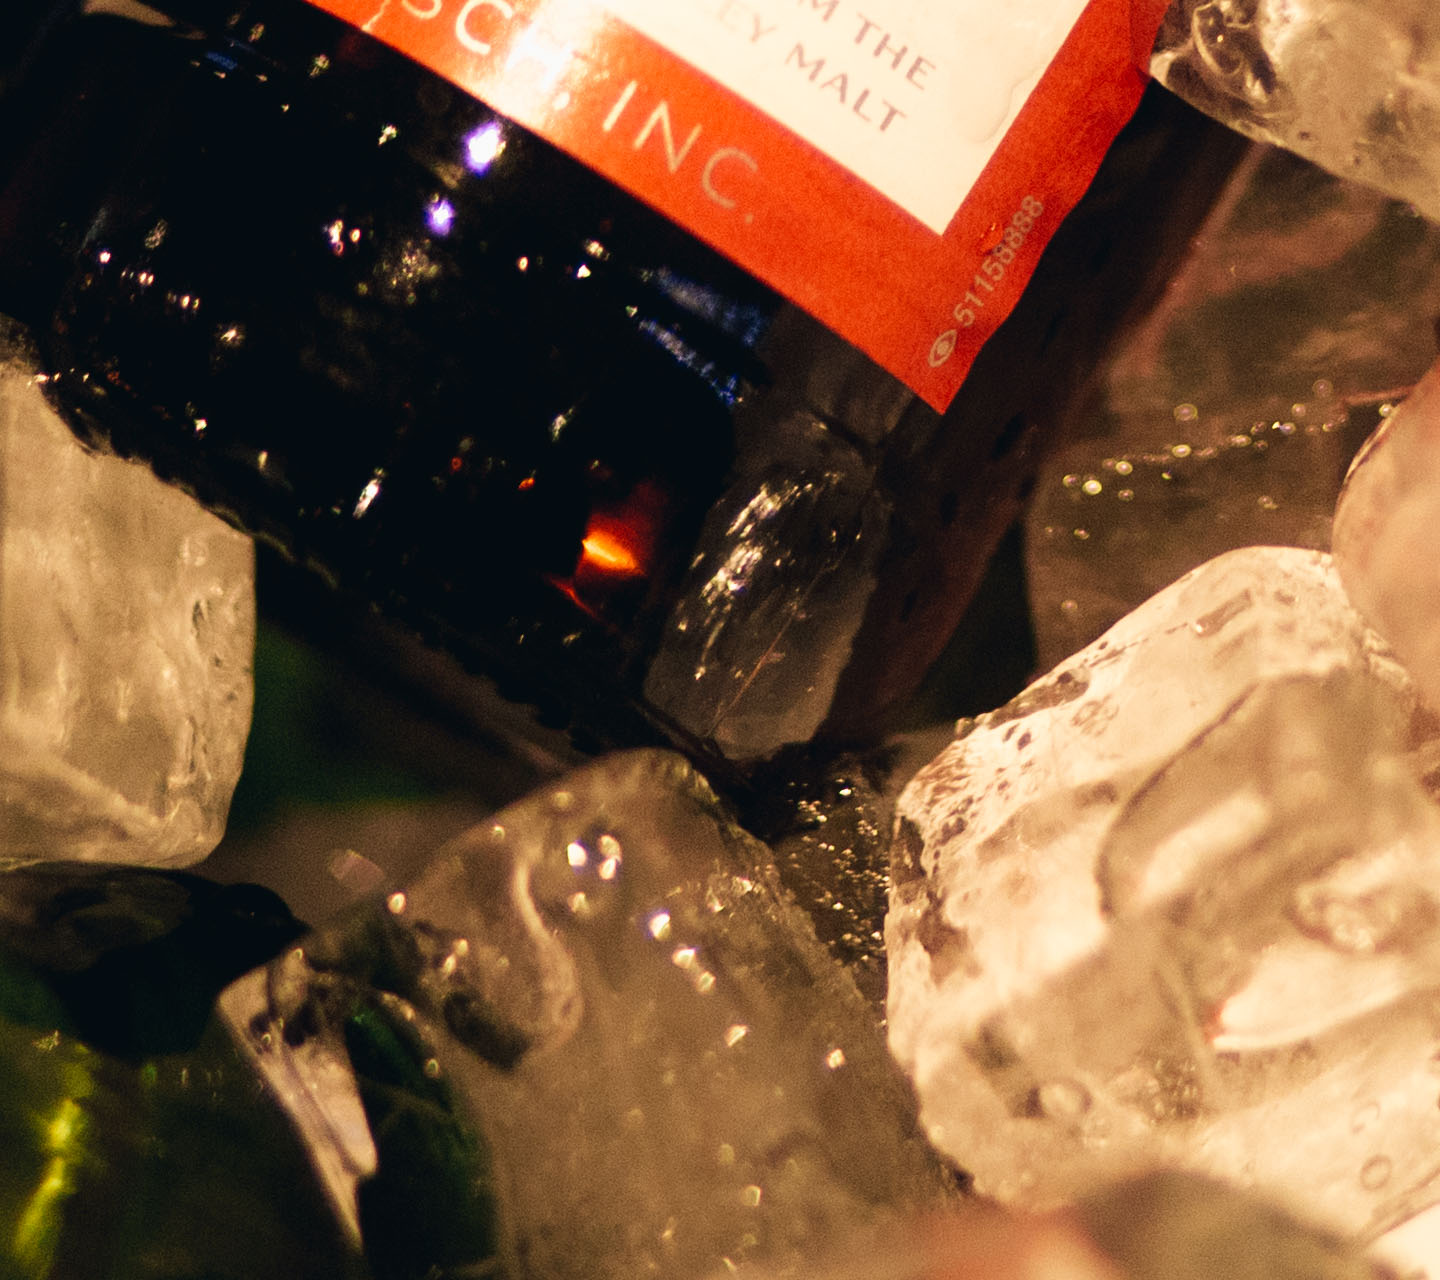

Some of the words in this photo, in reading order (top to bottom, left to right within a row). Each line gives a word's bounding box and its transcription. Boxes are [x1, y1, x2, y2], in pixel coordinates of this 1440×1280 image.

[782, 40, 910, 135] MALT
[851, 9, 939, 94] THE
[601, 79, 760, 226] INC.
[953, 195, 1045, 328] 51158888
